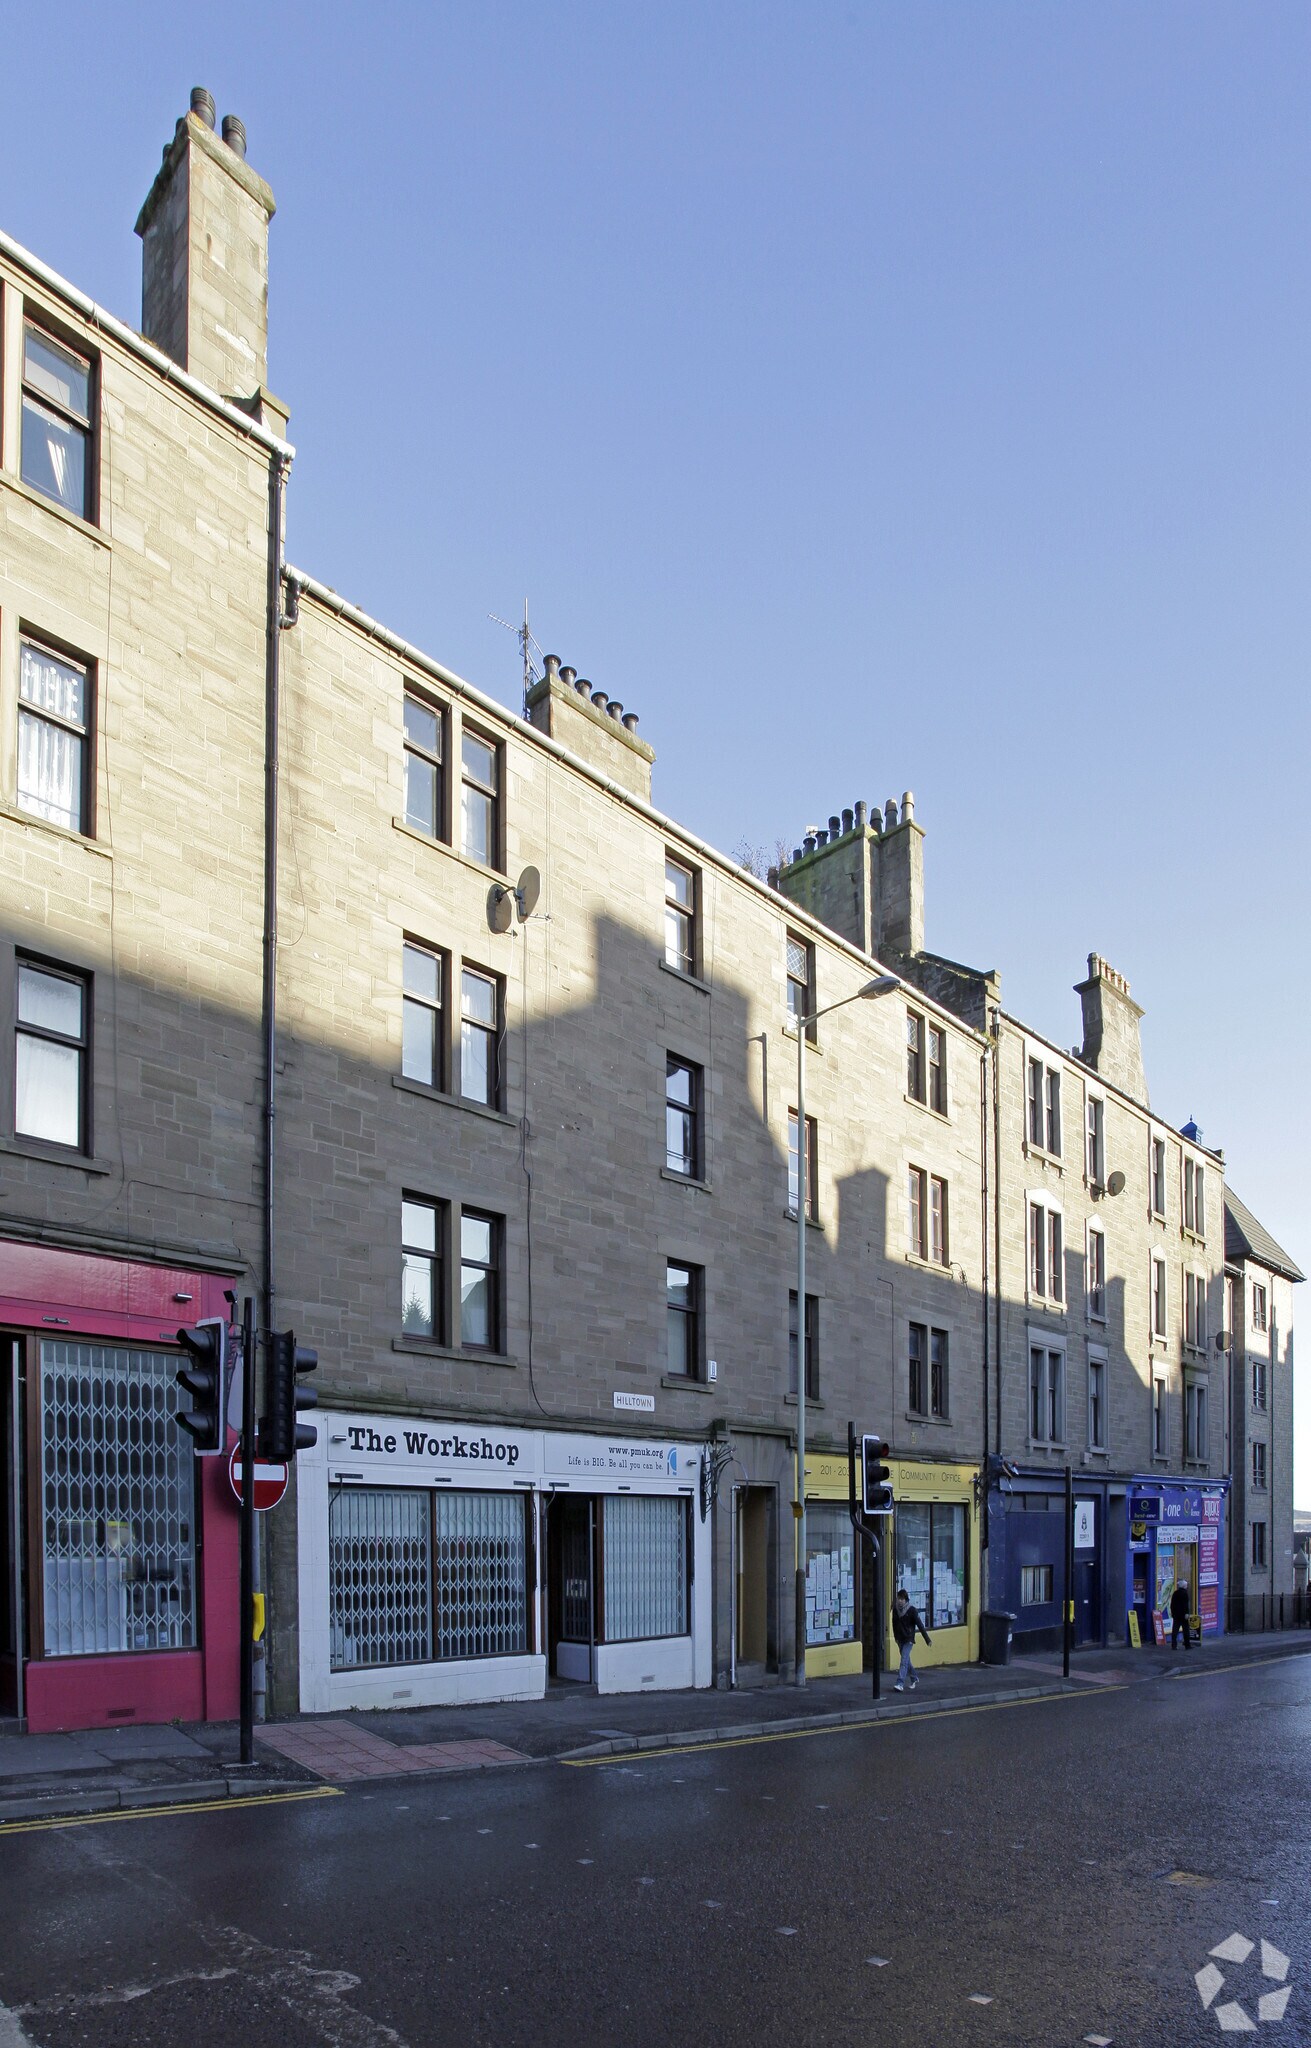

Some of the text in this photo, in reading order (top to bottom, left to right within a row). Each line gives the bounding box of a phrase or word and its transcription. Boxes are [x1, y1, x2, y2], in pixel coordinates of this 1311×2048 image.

[616, 1395, 652, 1408] HILLTOWN
[347, 1426, 520, 1466] The Workshop
[608, 1447, 664, 1459] www.pmuk.org
[568, 1456, 664, 1471] Life is BIG. Be all you can be.
[820, 1464, 832, 1476] 201
[900, 1469, 936, 1481] COMMUNITY
[941, 1472, 961, 1482] OFFICE
